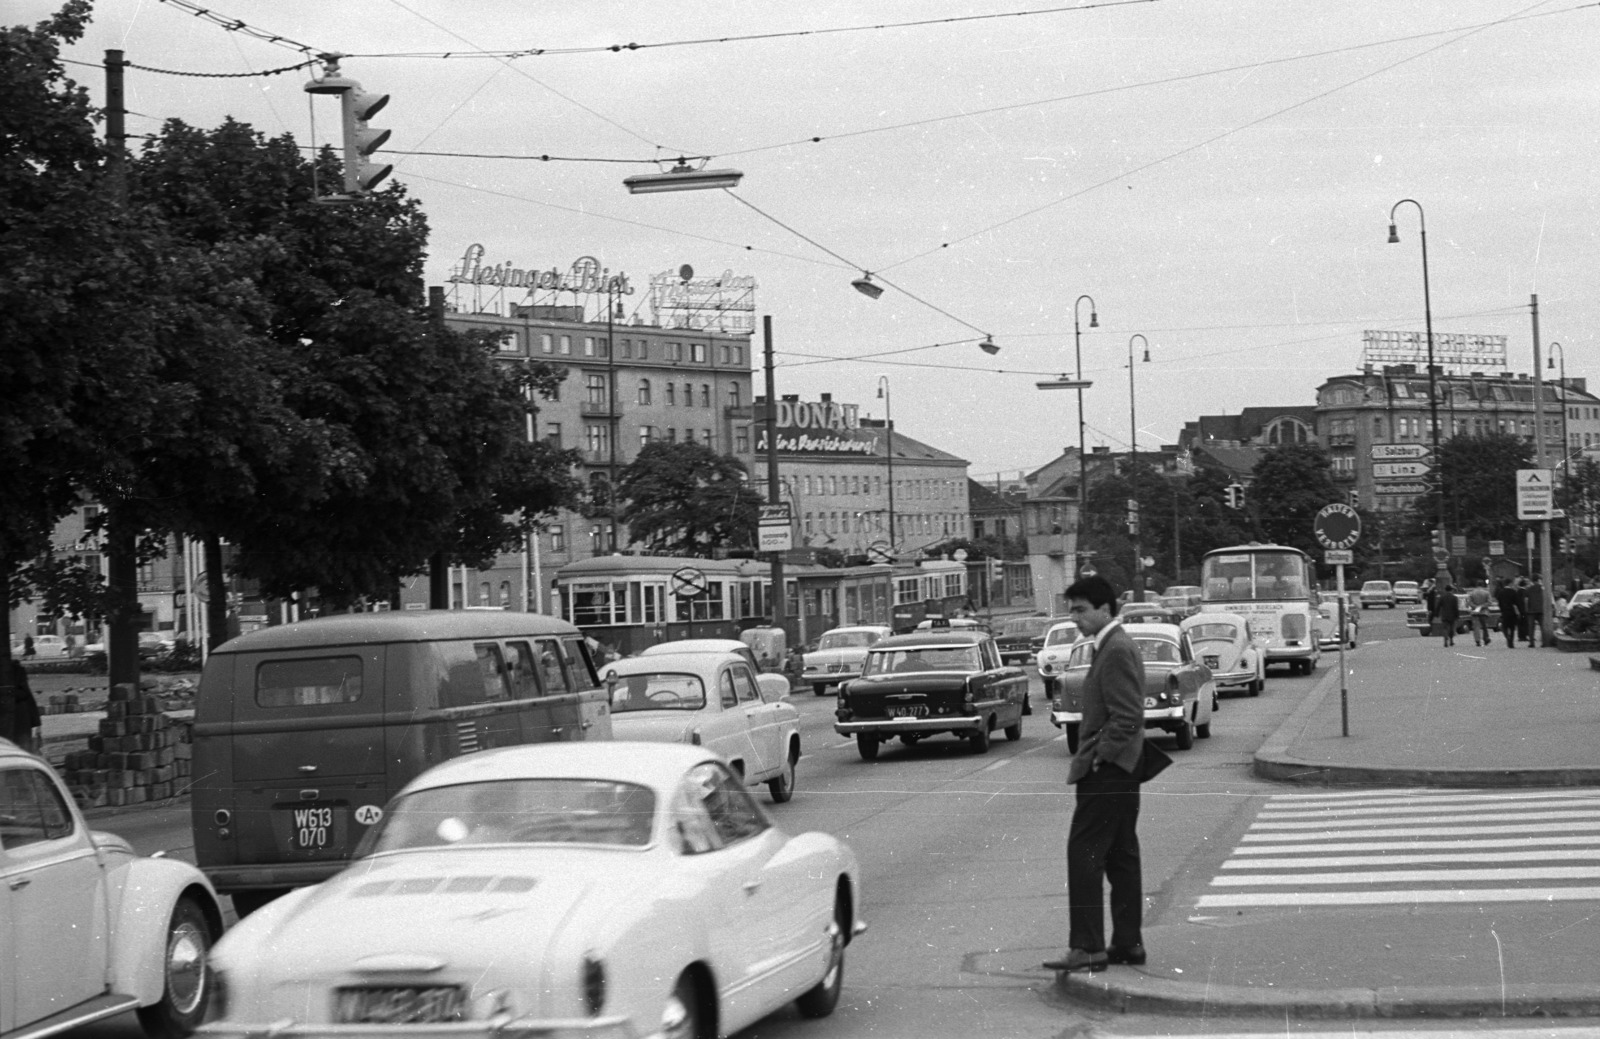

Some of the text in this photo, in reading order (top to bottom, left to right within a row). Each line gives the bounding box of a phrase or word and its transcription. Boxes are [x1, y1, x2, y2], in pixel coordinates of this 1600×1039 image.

[450, 243, 570, 297] Liesinger
[572, 256, 635, 295] Bier
[776, 401, 859, 429] DONAU
[1385, 446, 1420, 457] Salzburg
[1390, 465, 1416, 474] Linz
[1320, 504, 1354, 518] HALTEN
[1315, 529, 1359, 549] VERBOTEN
[888, 708, 896, 718] W
[294, 808, 332, 828] W613
[363, 807, 375, 822] A
[299, 827, 326, 847] 070
